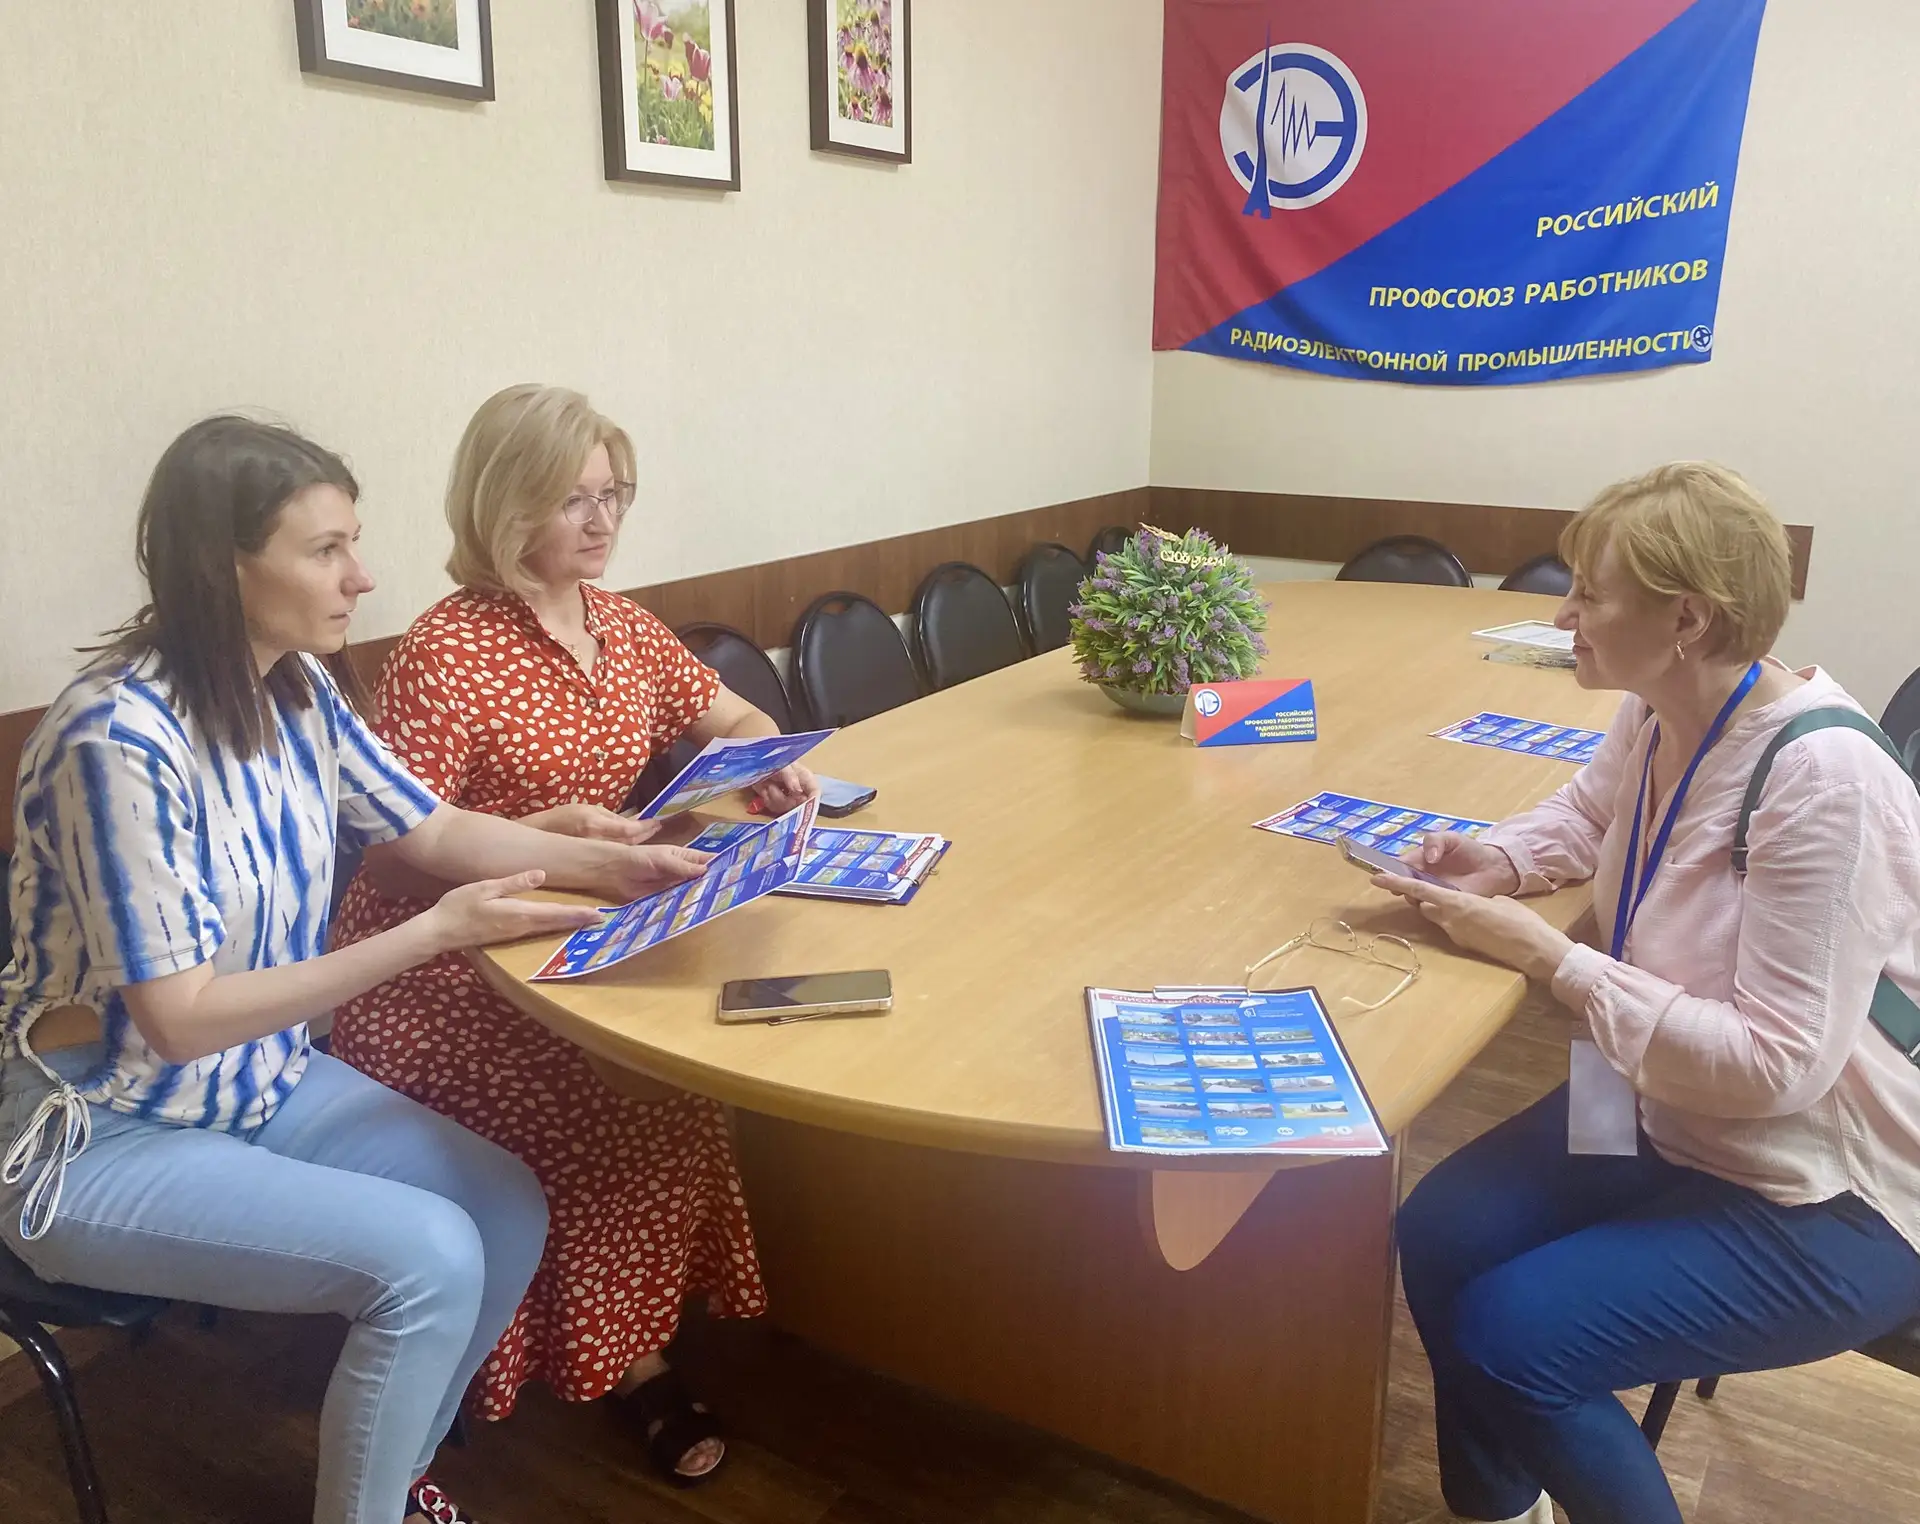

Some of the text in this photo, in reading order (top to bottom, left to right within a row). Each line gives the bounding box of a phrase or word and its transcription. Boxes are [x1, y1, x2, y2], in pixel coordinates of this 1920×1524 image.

[1536, 182, 1719, 238] РОССИЙСКИЙ
[1369, 259, 1709, 309] ПРОФСОЮЗ РАБОТНИКОВ
[1230, 328, 1448, 373] РАДИОЭЛЕКТРОННОЙ
[1275, 709, 1313, 717] РОССИЙСКИЙ
